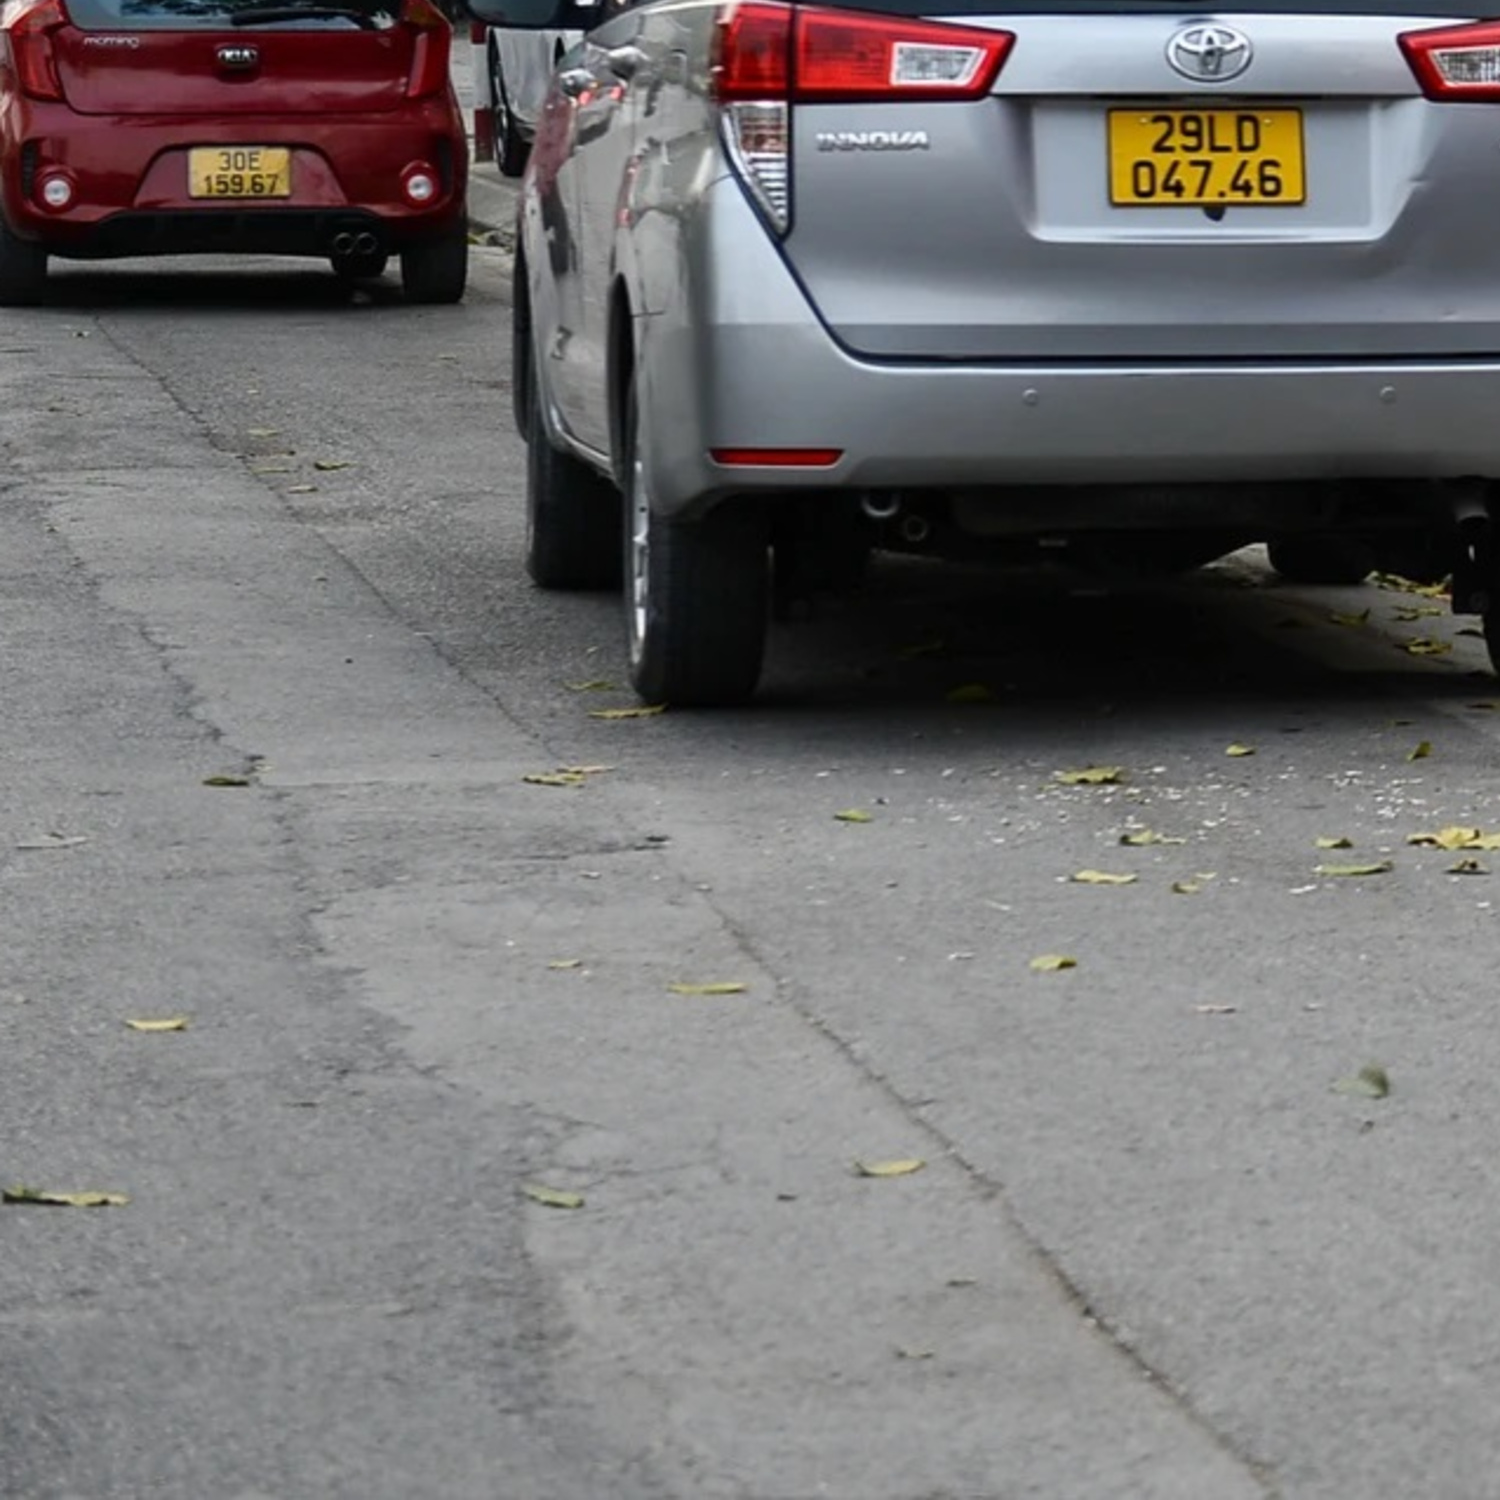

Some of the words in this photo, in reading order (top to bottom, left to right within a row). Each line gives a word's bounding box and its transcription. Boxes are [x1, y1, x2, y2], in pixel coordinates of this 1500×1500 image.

[84, 35, 140, 49] morning
[222, 48, 253, 62] KIA
[816, 131, 930, 151] INNOVA
[1151, 115, 1261, 153] 29LD
[218, 151, 260, 172] 30E
[204, 174, 280, 195] 159.67
[1132, 160, 1283, 198] 047.46
